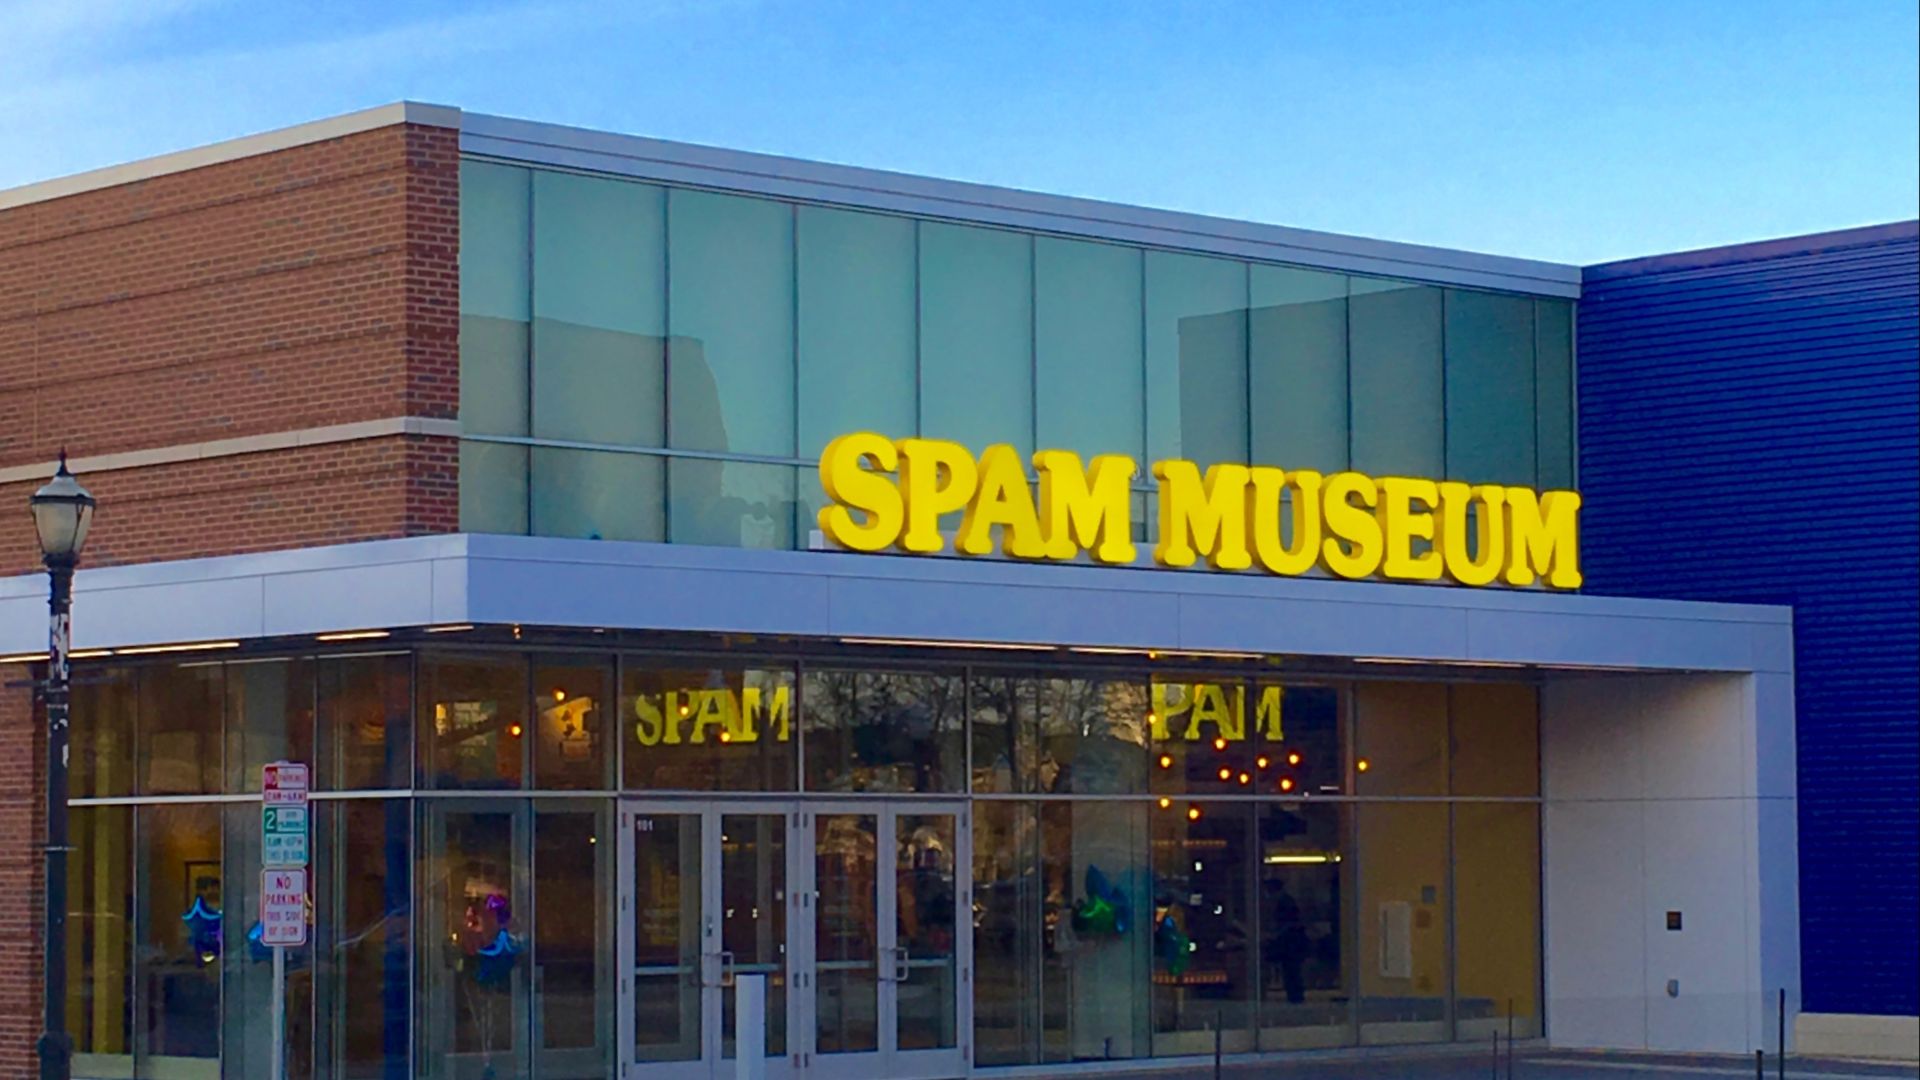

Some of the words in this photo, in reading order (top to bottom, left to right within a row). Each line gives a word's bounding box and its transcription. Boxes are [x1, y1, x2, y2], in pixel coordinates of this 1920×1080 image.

[818, 430, 1136, 564] SPAM
[1152, 458, 1583, 589] MUSEUM
[634, 686, 790, 746] SPAM
[265, 810, 276, 830] 2
[276, 876, 292, 890] NO
[265, 893, 302, 905] PARKING
